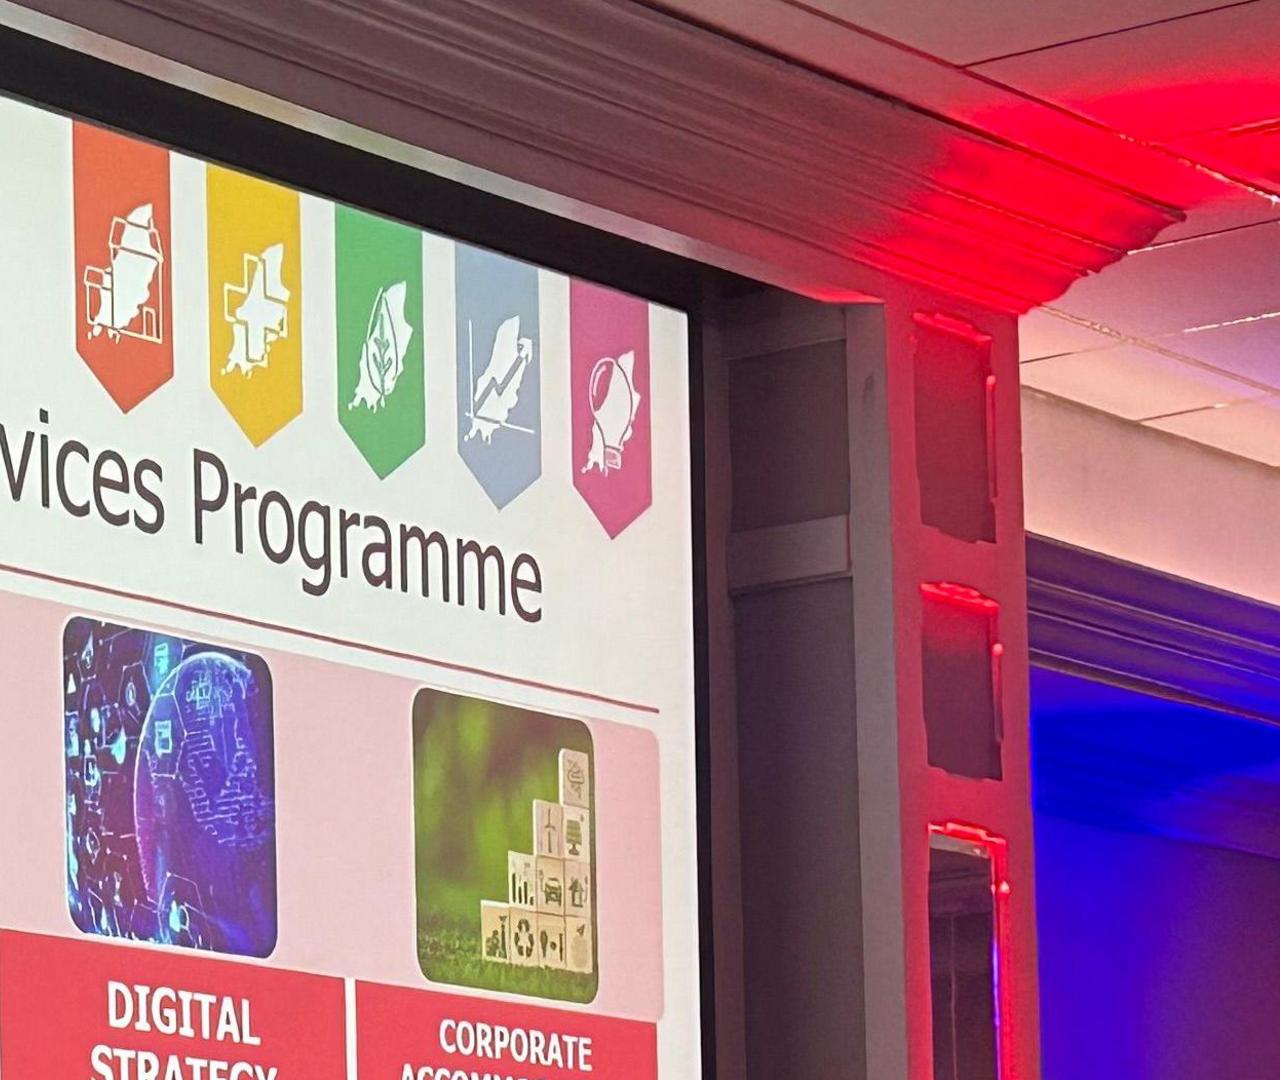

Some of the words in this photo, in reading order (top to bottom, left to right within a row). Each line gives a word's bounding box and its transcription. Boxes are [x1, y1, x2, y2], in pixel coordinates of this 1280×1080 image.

[194, 449, 542, 623] Programme
[108, 981, 260, 1045] DIGITAL
[440, 1019, 592, 1071] CORPORATE
